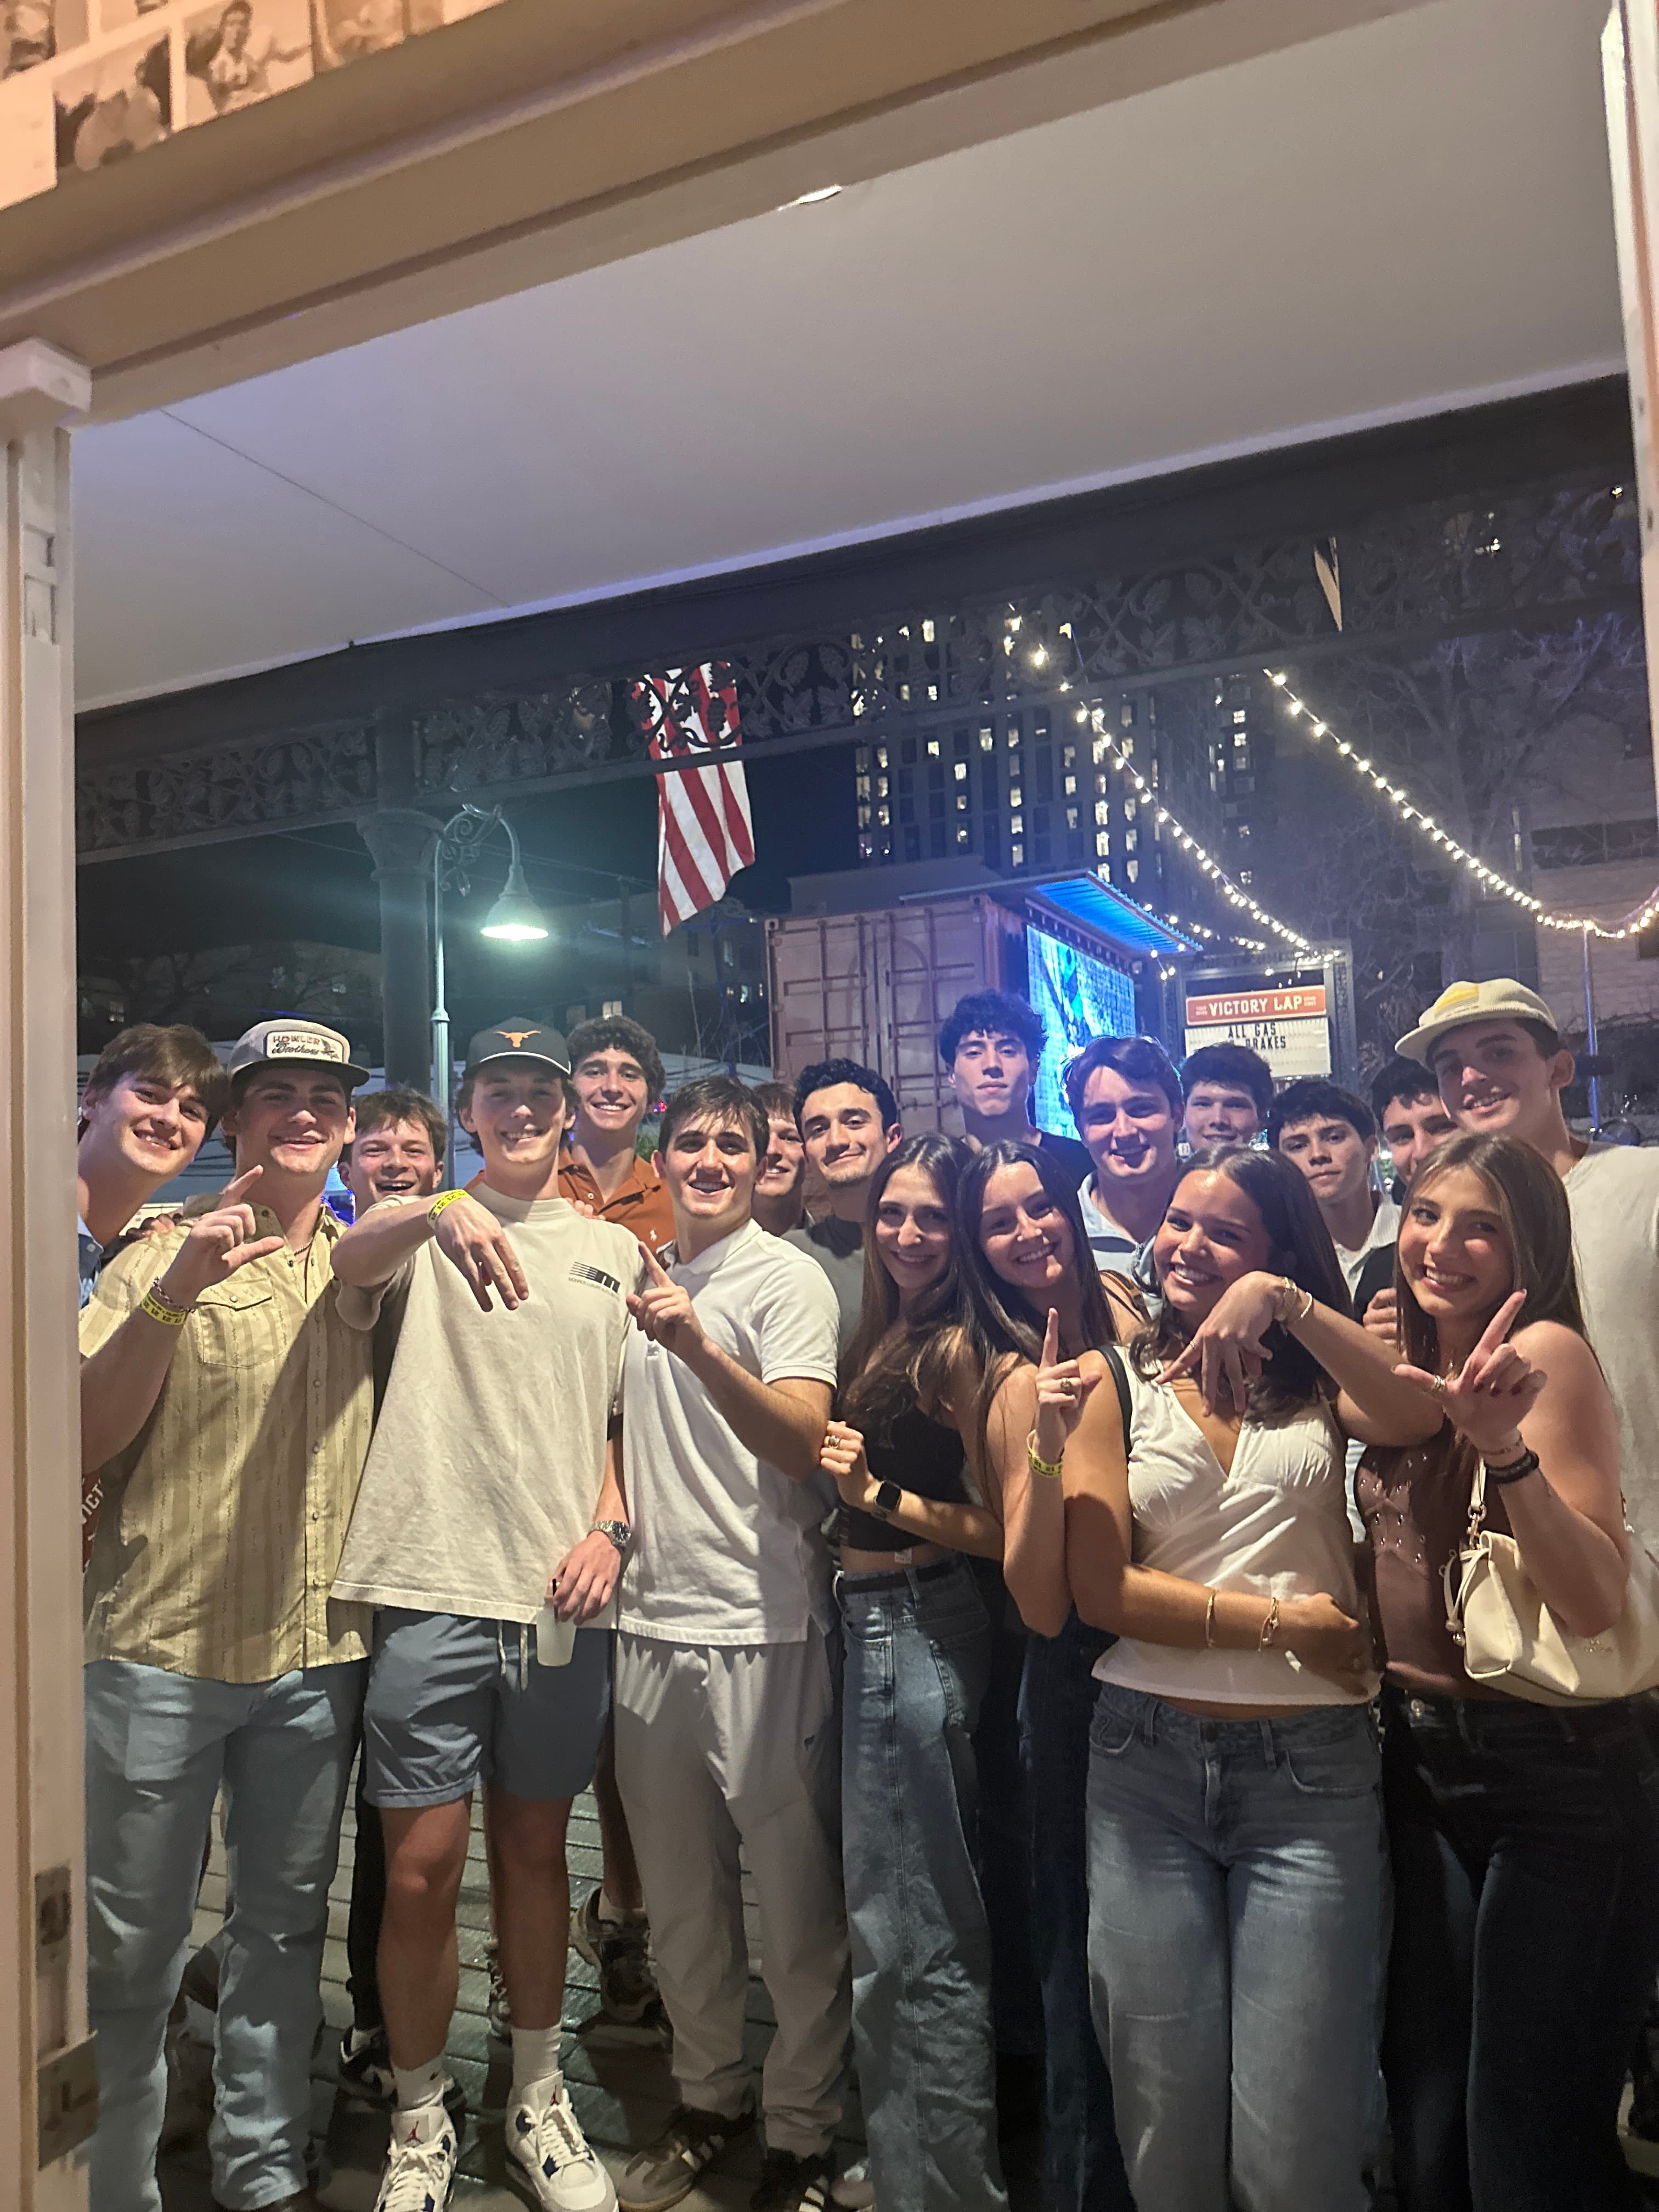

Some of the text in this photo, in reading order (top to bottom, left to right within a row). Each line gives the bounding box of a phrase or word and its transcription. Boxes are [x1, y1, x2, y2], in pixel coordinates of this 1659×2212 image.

[1209, 997, 1268, 1017] VICTORY
[1273, 995, 1302, 1011] LAP
[1228, 1022, 1276, 1039] ALL GAS
[273, 1035, 320, 1045] HOWLER
[272, 1041, 320, 1055] Brothers
